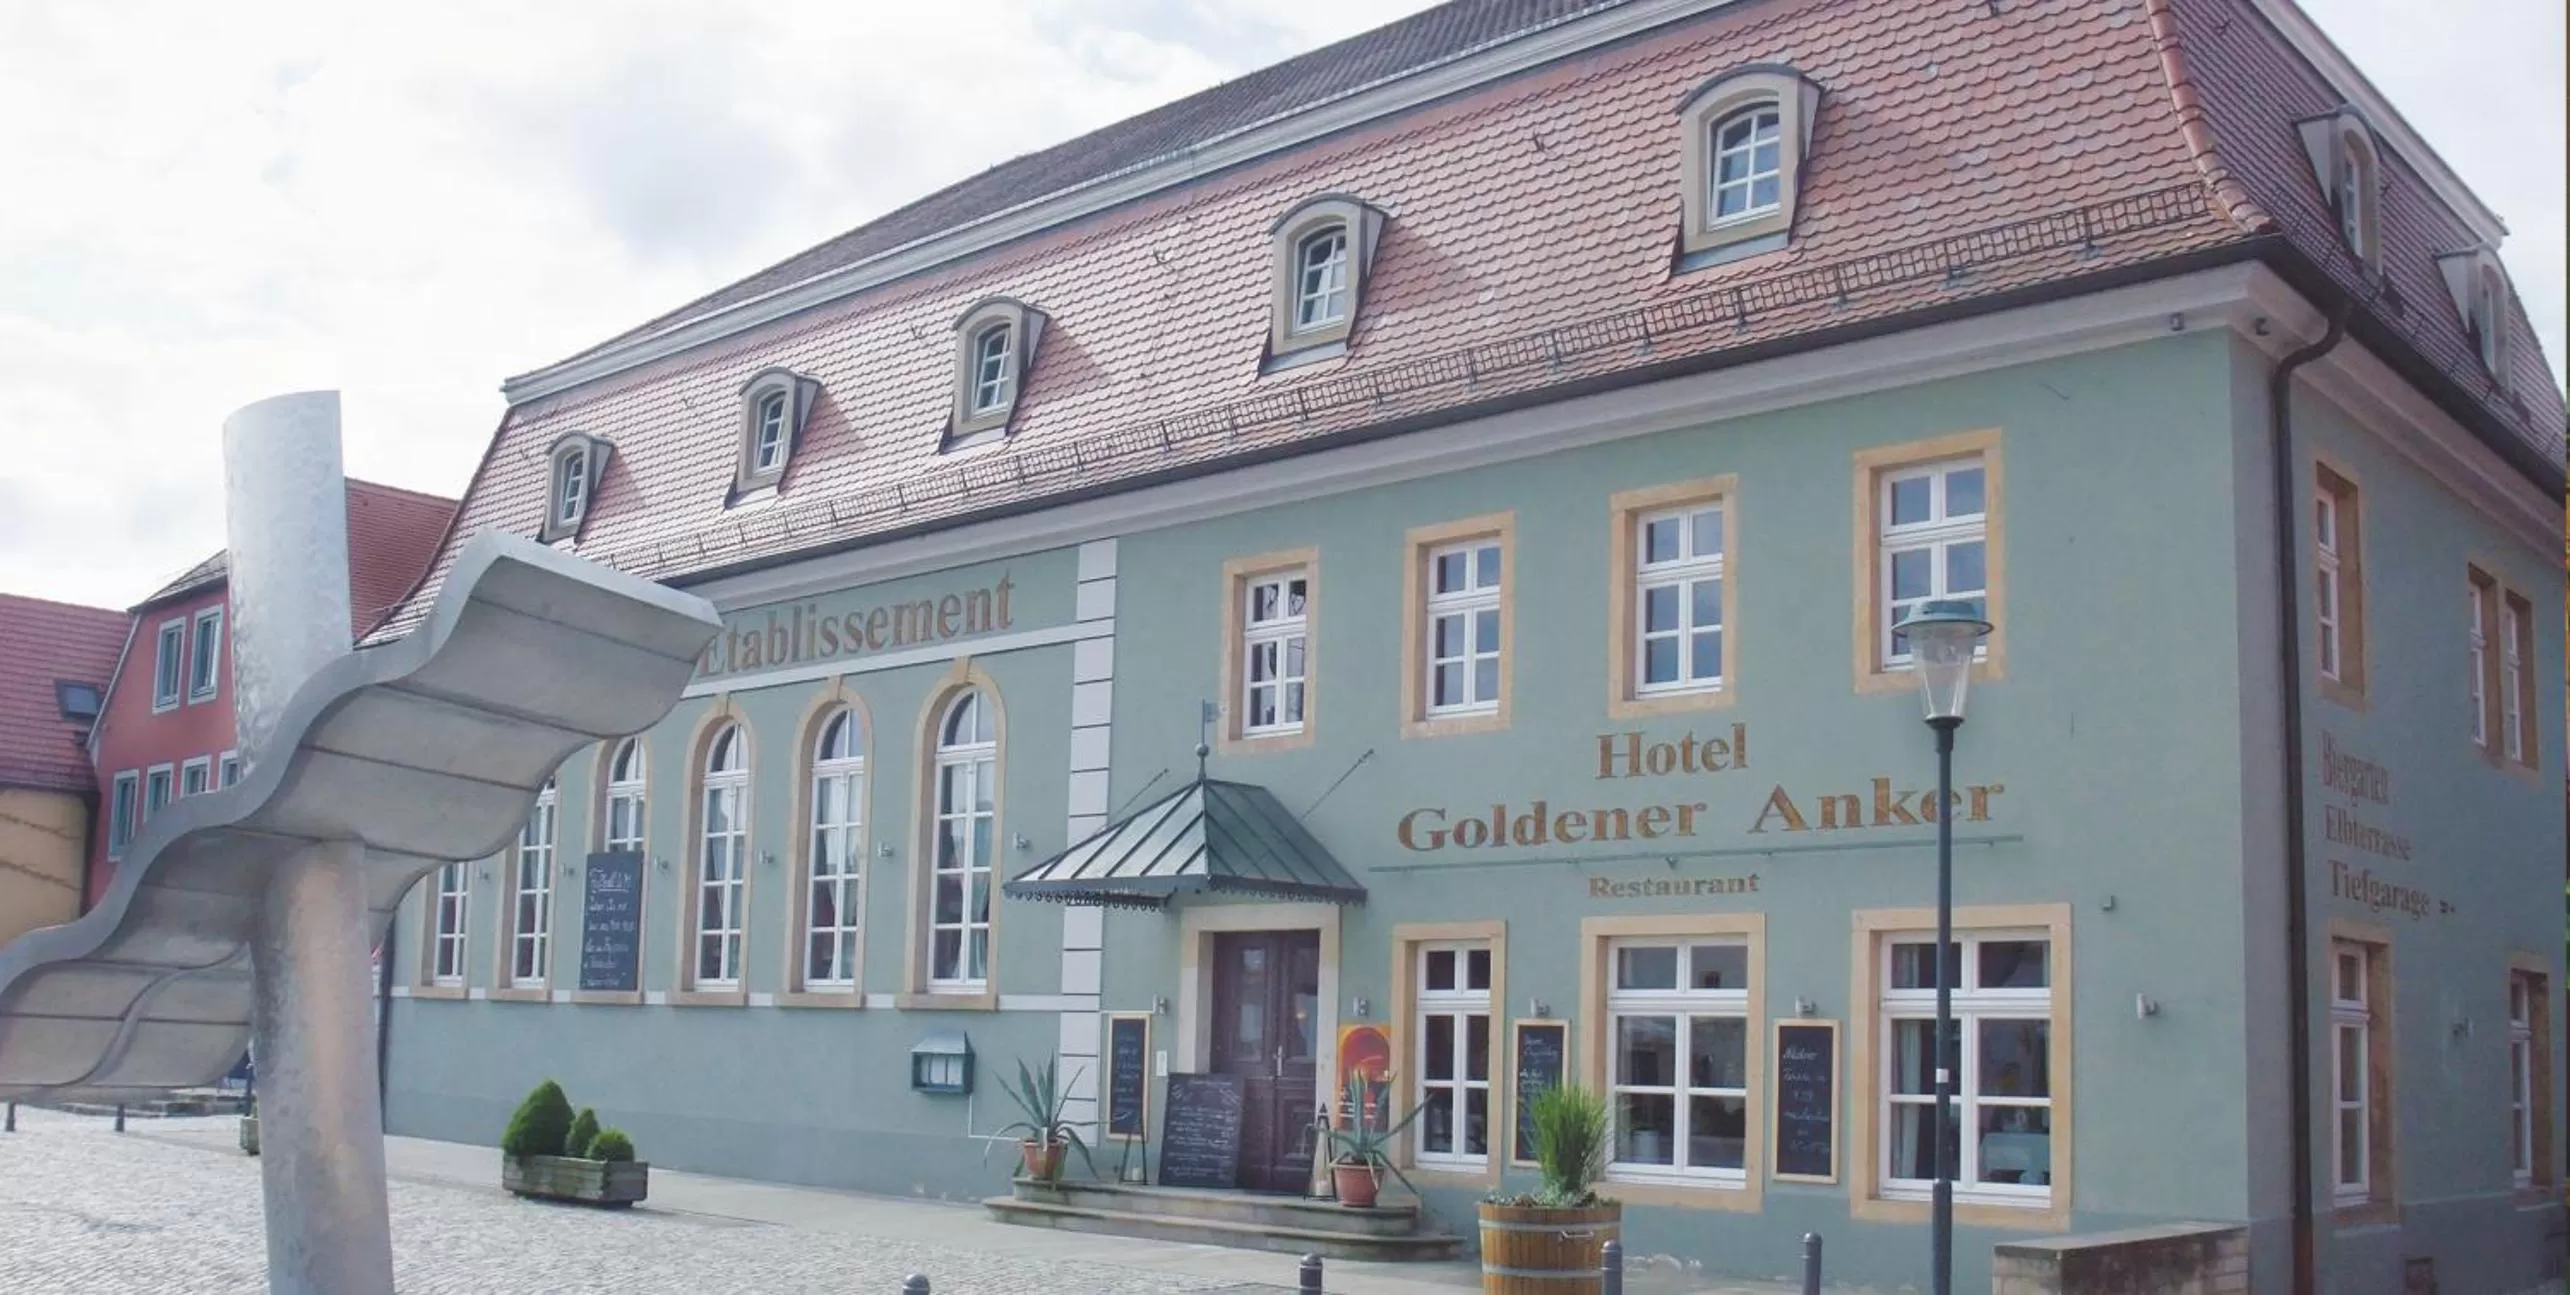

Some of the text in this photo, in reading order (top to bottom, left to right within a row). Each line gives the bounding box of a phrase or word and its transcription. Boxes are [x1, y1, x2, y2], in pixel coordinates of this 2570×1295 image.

[1595, 722, 1750, 780] Hotel
[1397, 777, 2006, 853] Goldener Anker
[1588, 873, 1761, 898] Restaurant
